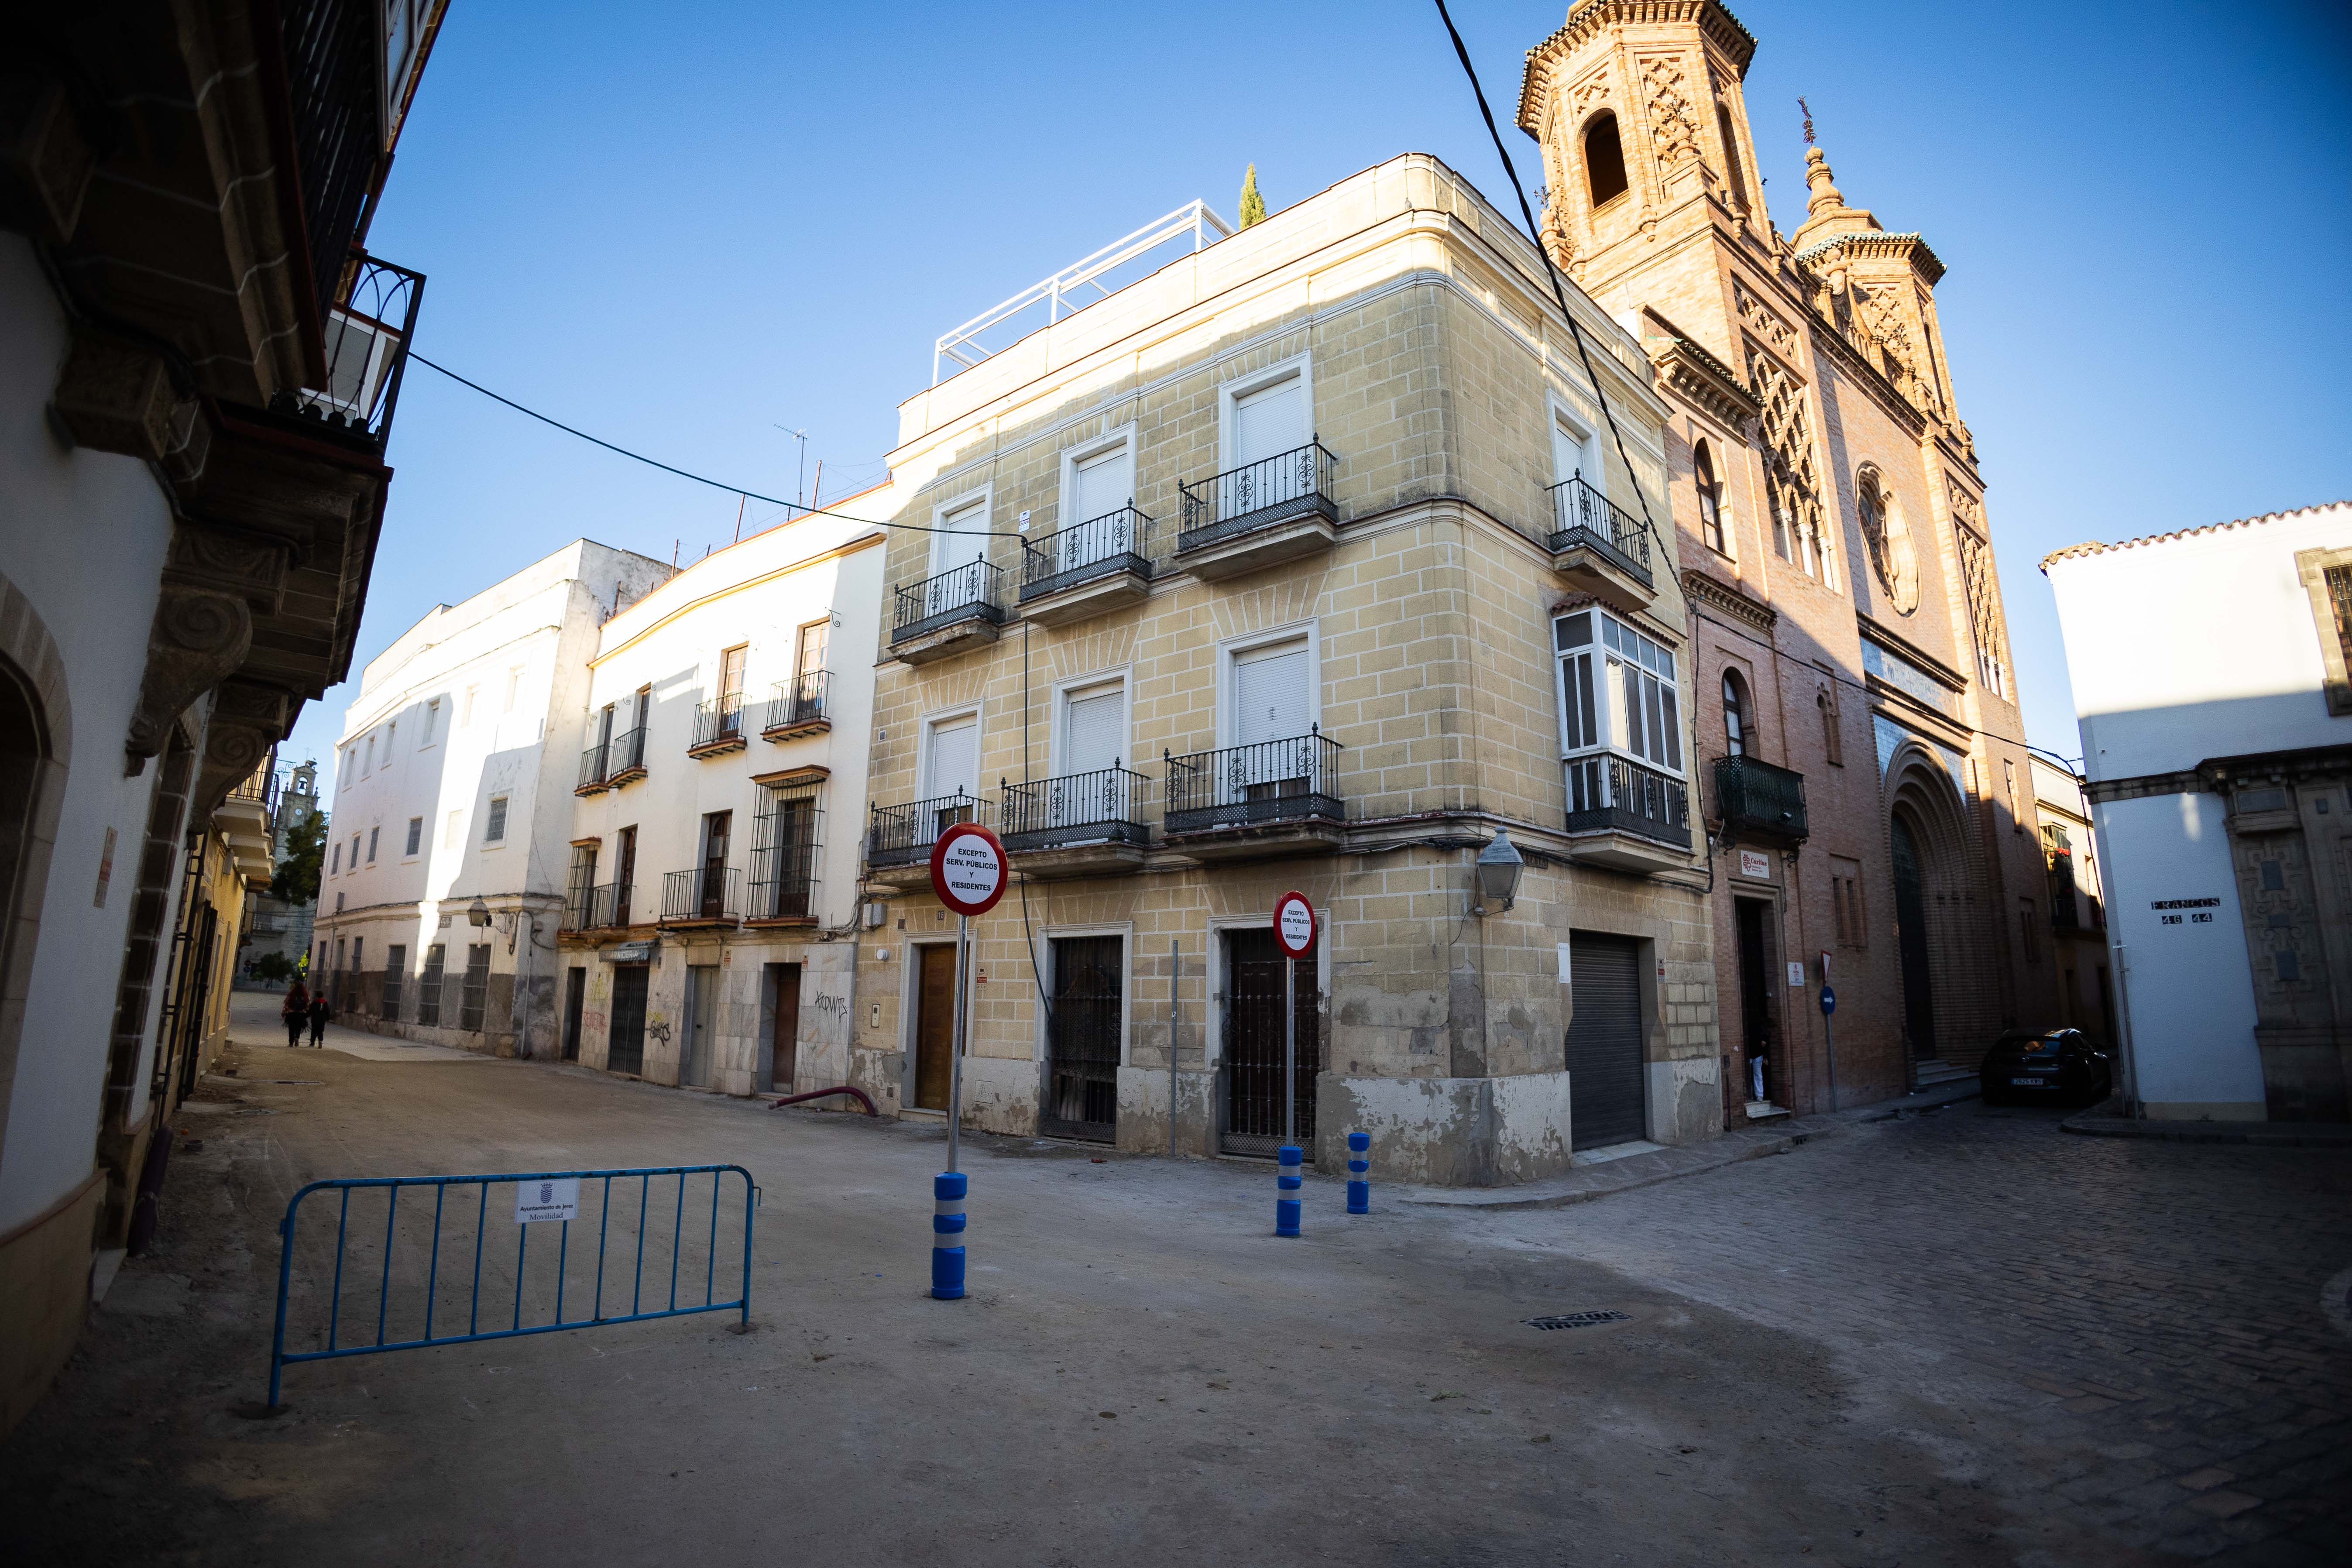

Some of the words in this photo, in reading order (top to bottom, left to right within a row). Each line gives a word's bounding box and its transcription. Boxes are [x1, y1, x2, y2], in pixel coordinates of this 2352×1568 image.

[958, 848, 987, 858] EXCEPTO
[966, 860, 997, 870] PÚBLICOS
[951, 881, 991, 891] RESIDENTES
[2193, 913, 2212, 923] 44
[529, 1212, 563, 1221] Movilidad
